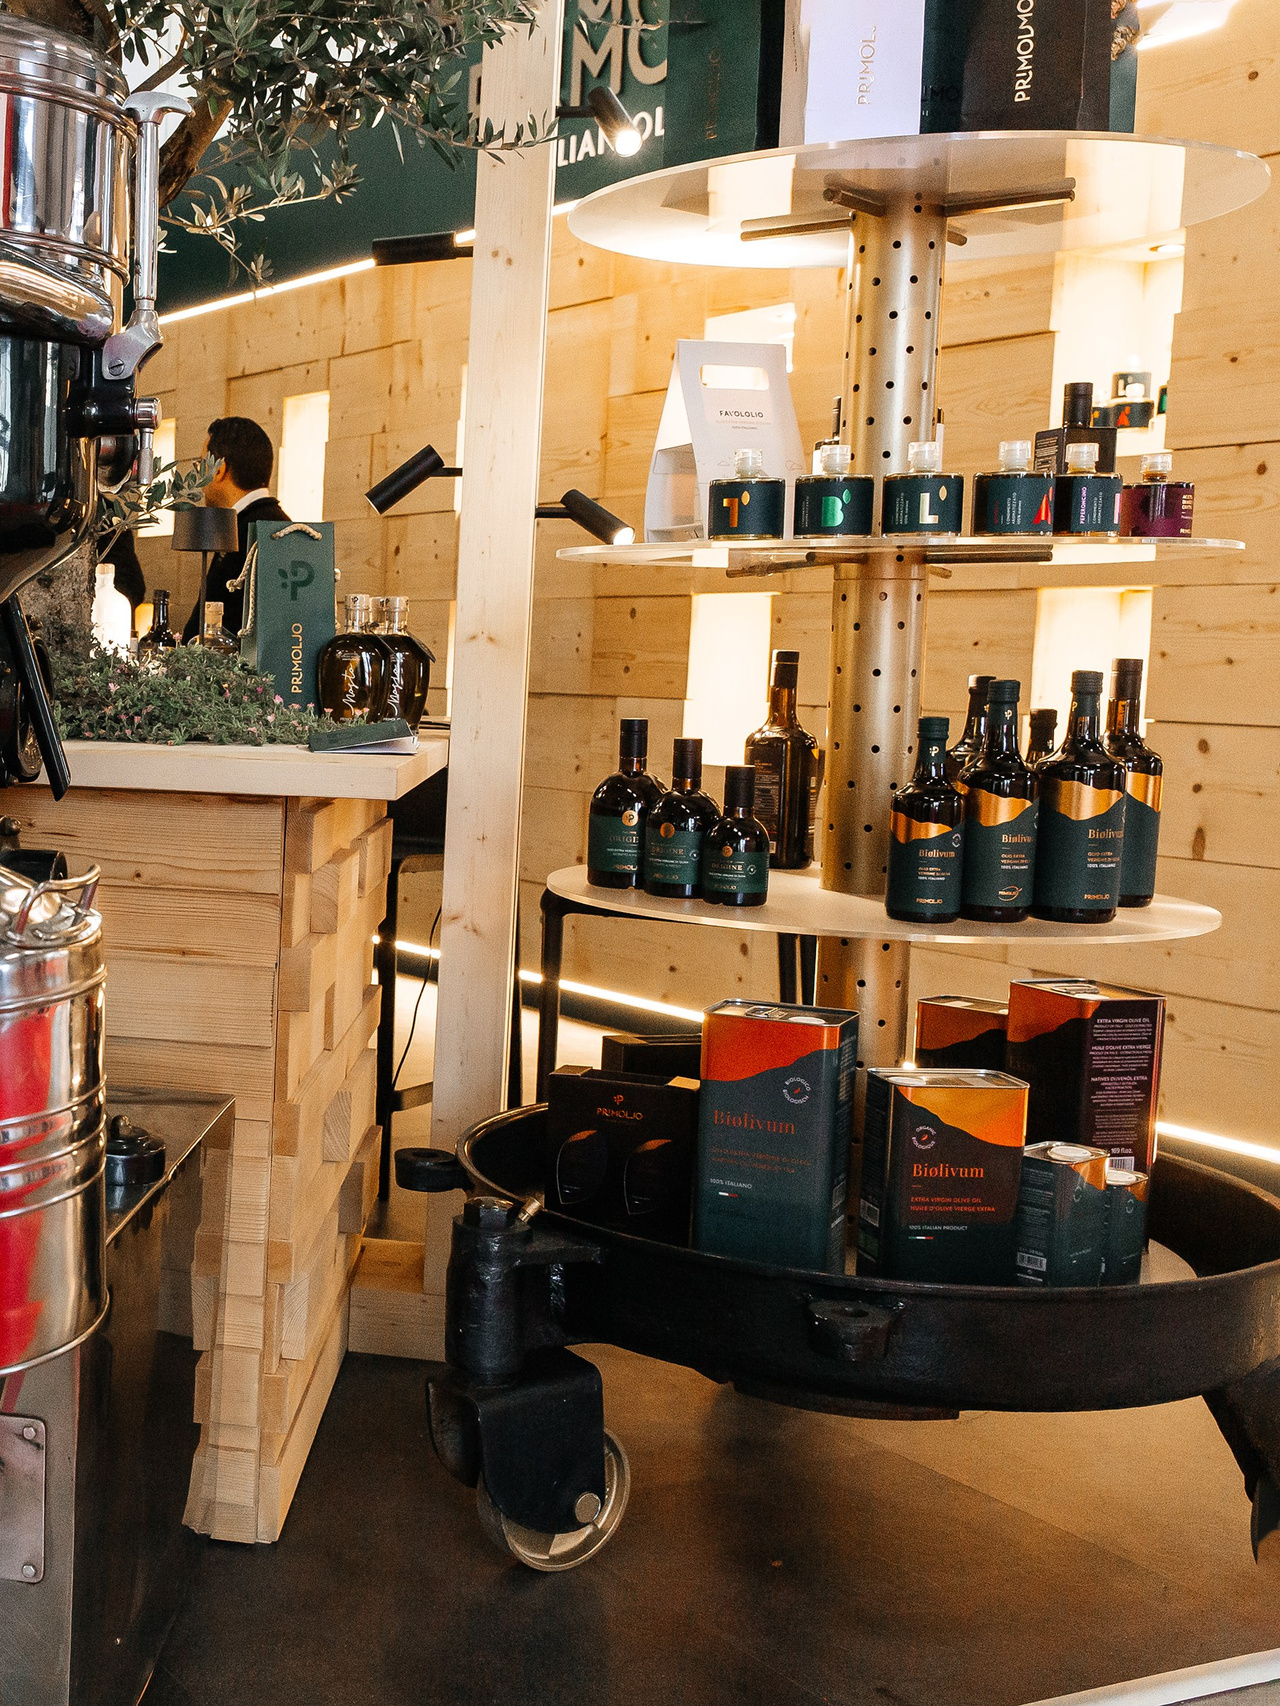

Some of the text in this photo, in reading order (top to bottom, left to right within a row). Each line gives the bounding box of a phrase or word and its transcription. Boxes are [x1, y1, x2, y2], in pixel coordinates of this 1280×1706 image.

[855, 25, 877, 106] PRIMOL
[919, 492, 939, 524] L
[291, 623, 303, 694] PRIMOLJO
[596, 1107, 643, 1120] PRIMOLJO
[725, 1180, 753, 1189] ITALIANO
